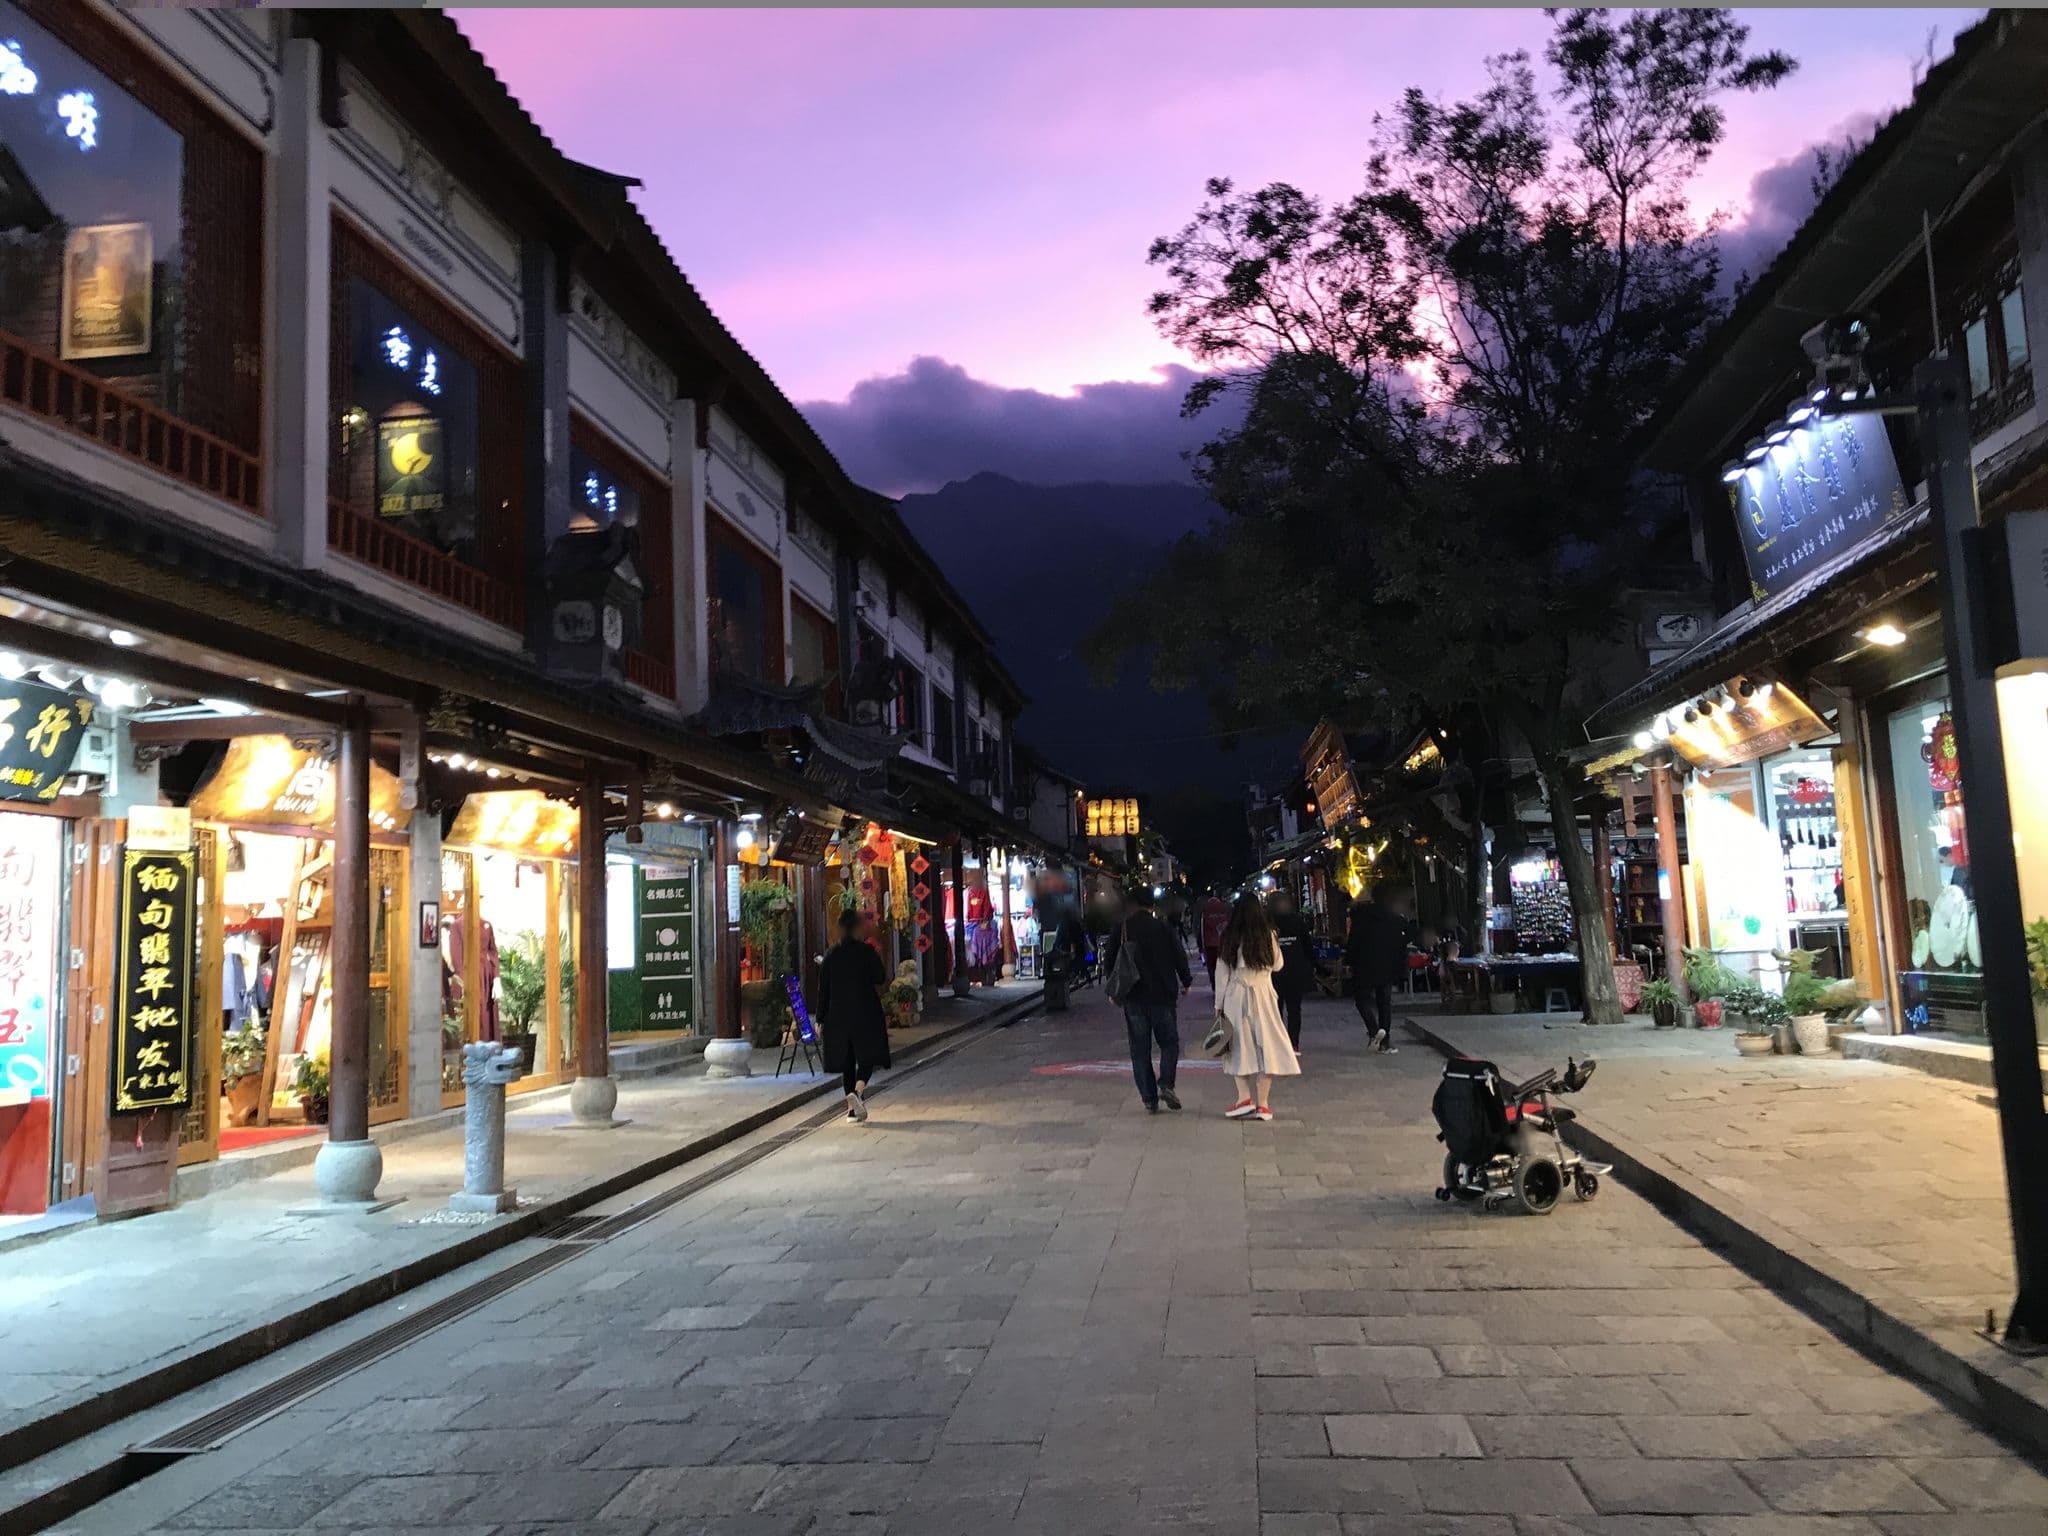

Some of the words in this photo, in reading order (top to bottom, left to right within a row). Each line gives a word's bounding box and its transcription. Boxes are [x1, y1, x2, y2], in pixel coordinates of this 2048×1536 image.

[131, 865, 180, 1071] 缅甸翡翠批发
[649, 1010, 687, 1020] 公共卫生间
